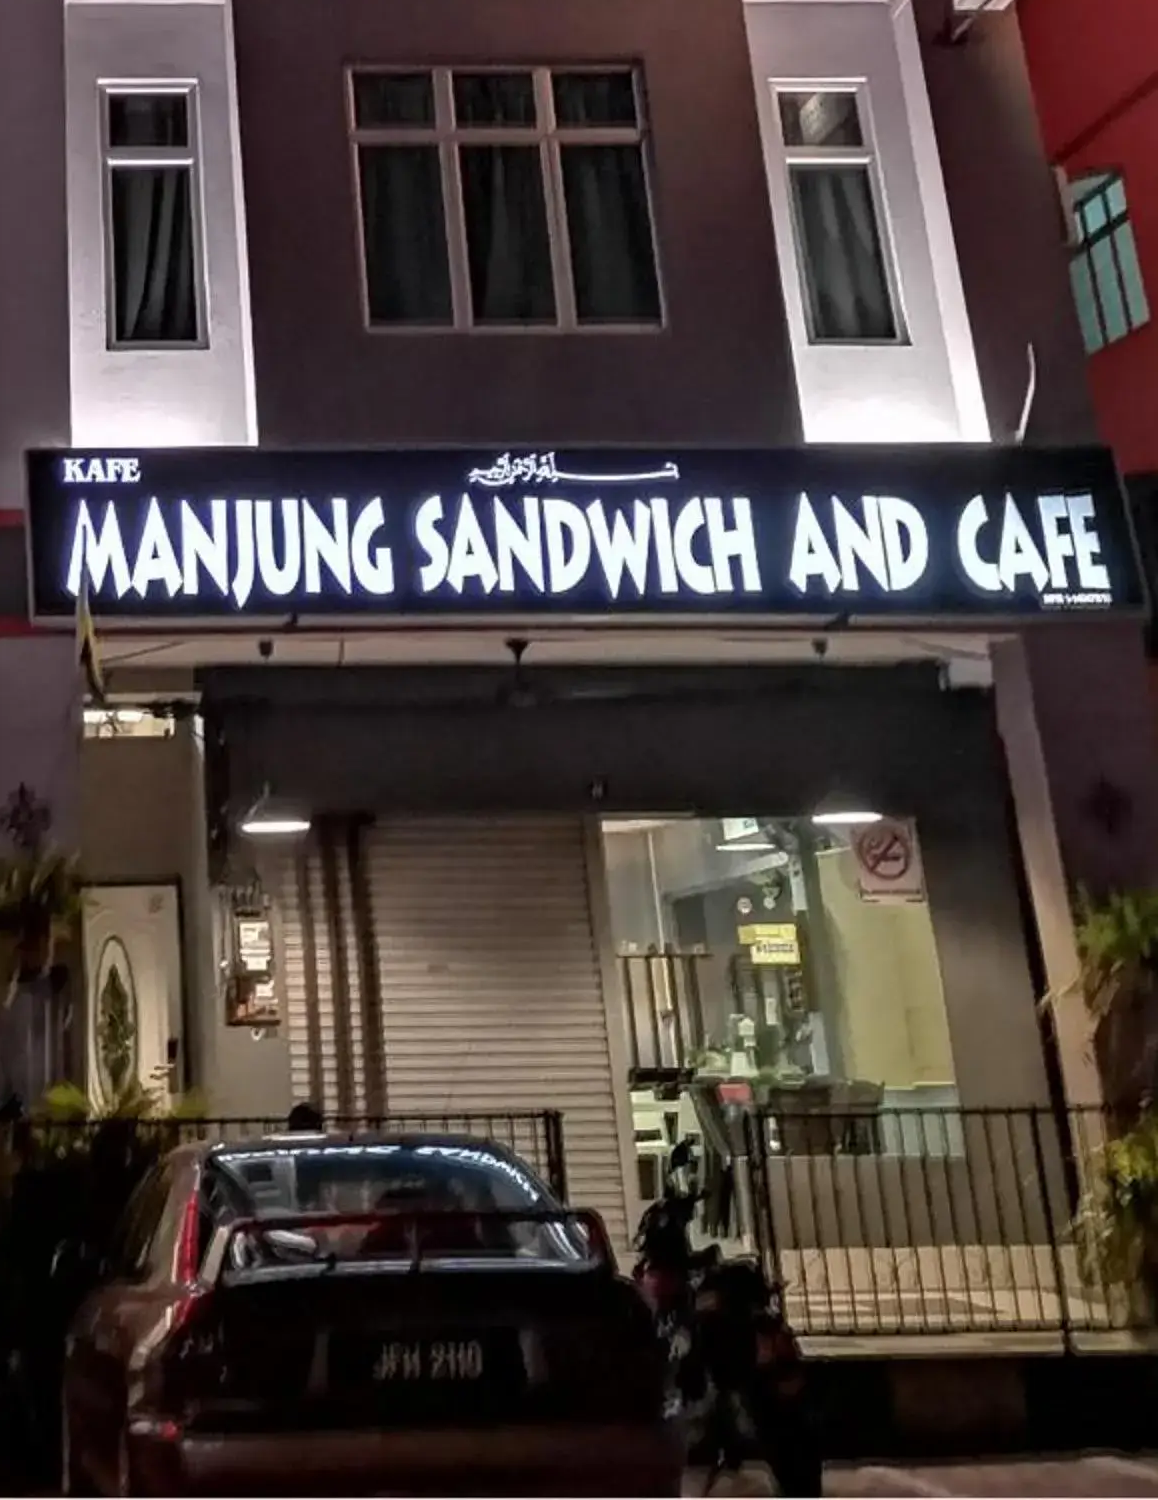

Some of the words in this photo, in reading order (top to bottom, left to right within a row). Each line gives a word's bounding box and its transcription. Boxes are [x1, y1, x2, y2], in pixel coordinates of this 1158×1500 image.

[63, 457, 141, 483] KAFE
[66, 495, 396, 609] MANJUNG
[414, 491, 763, 600] SANDWICH
[789, 491, 929, 593] AND
[957, 491, 1111, 593] CAFE
